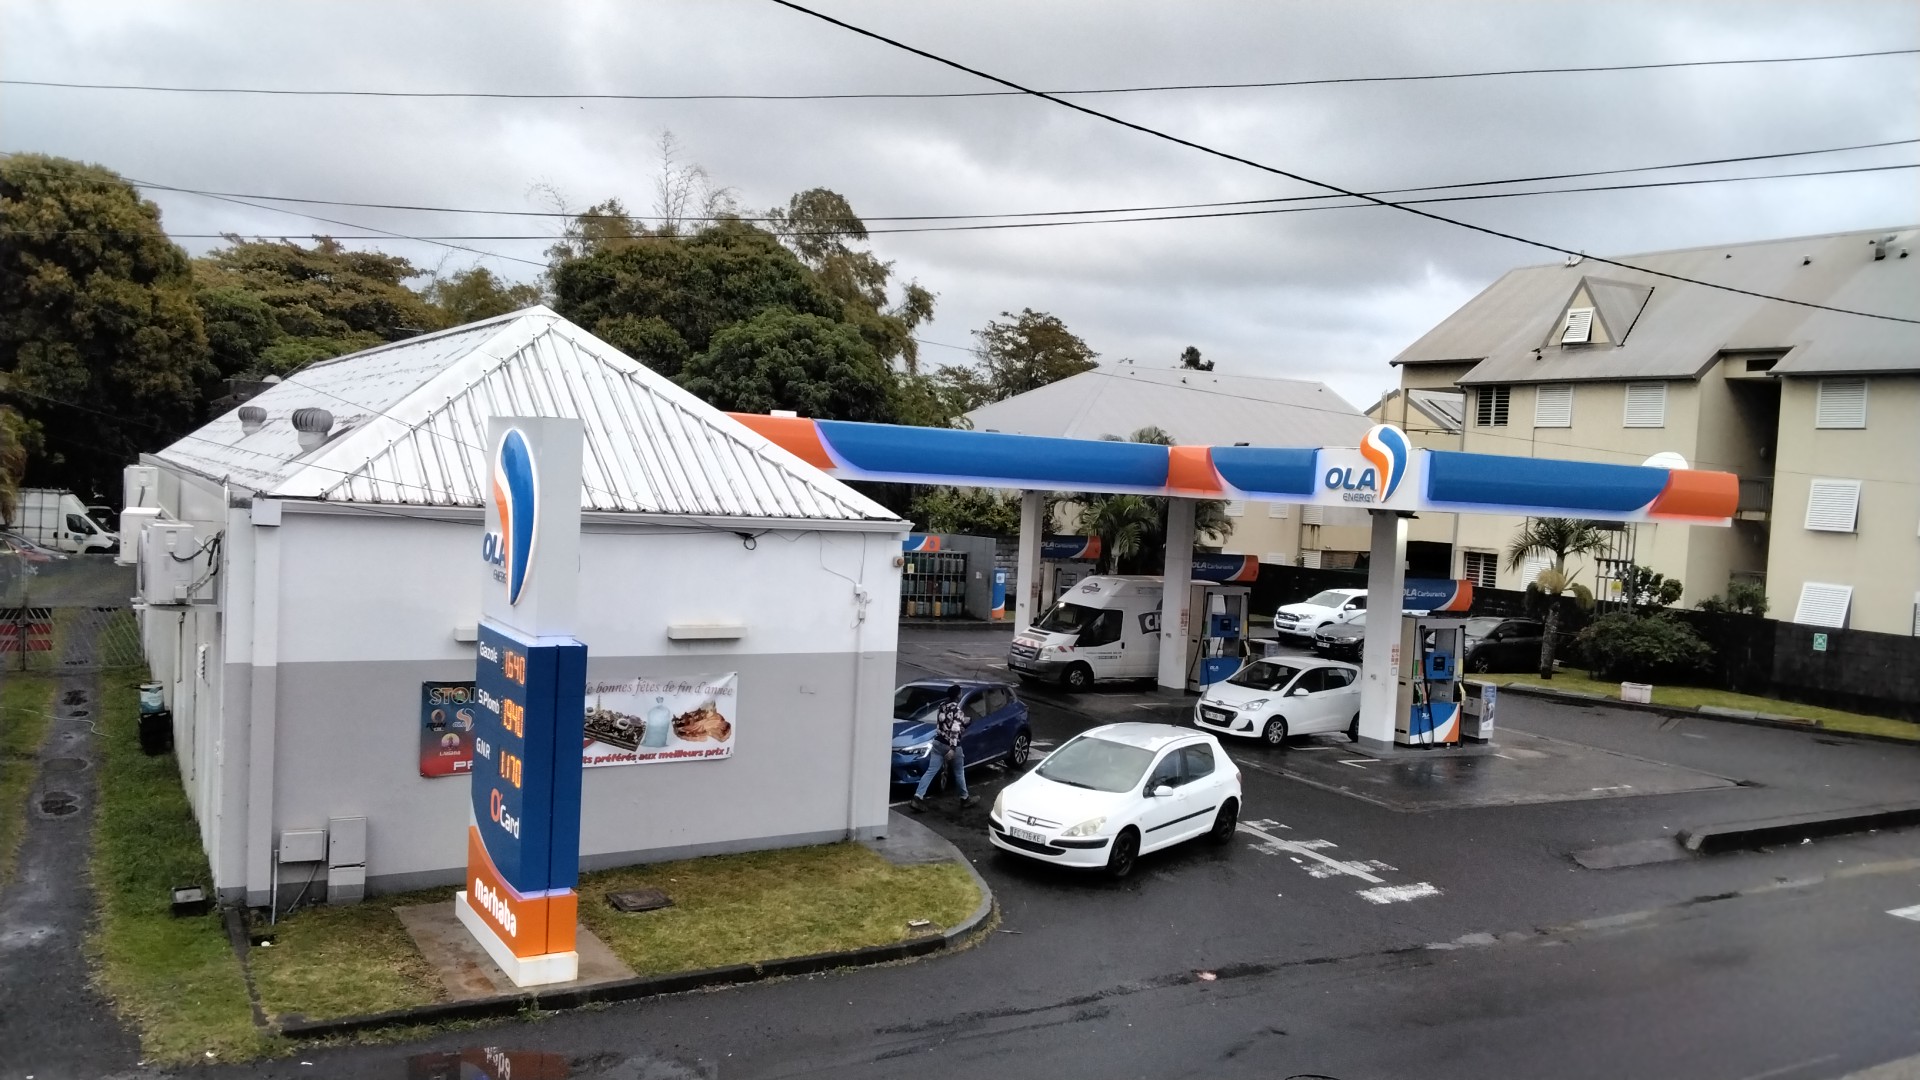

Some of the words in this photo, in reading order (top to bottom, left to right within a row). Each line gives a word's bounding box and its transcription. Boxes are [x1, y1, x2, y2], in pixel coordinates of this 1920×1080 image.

[1325, 467, 1377, 491] OLA
[1342, 492, 1378, 503] ENERGY
[482, 532, 506, 568] OLA
[1417, 590, 1447, 598] Carburants
[479, 641, 498, 664] Gazole
[595, 681, 633, 694] bonnes
[632, 679, 660, 697] fêtes
[662, 680, 675, 693] de
[673, 680, 692, 697] fin
[594, 752, 637, 765] préférés
[638, 752, 657, 761] aux
[658, 749, 704, 759] meilleurs
[704, 747, 725, 758] prix
[726, 746, 730, 755] !
[474, 877, 518, 938] marhaba
